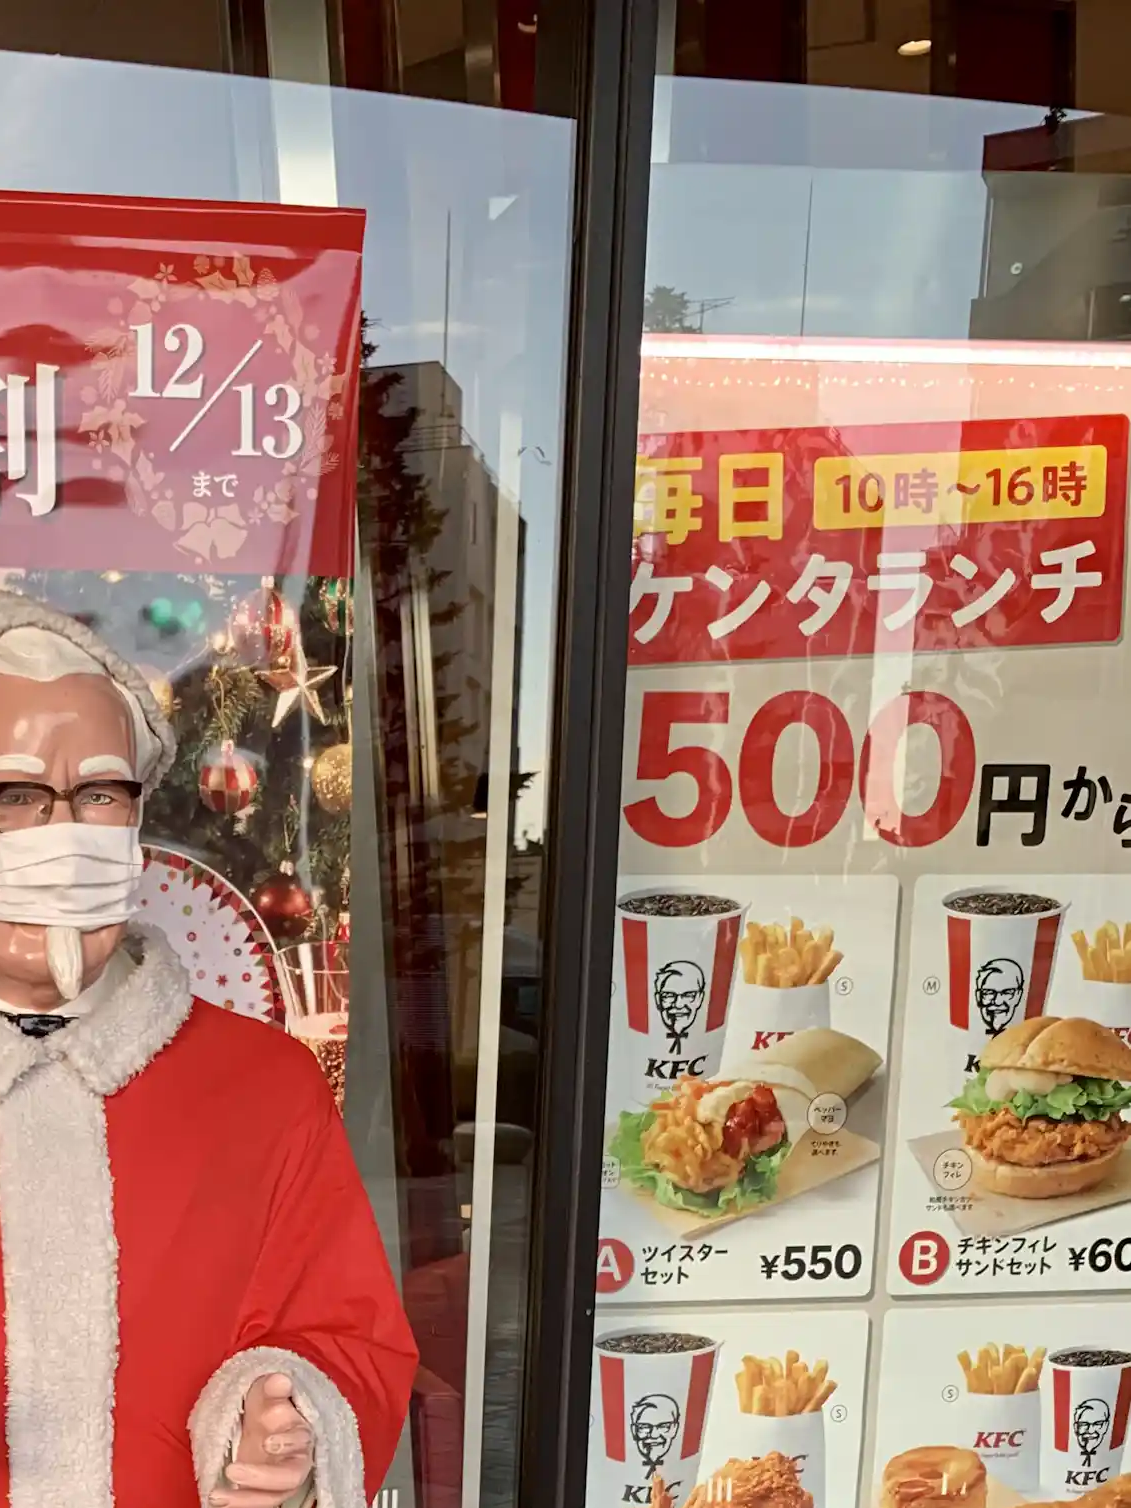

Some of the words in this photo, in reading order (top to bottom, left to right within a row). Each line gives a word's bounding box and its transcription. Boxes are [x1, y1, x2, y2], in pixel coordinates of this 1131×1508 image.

[191, 470, 239, 498] まで
[633, 452, 784, 545] 毎日
[629, 539, 1103, 645] ケンタランチ
[644, 1054, 708, 1080] KFC
[942, 1161, 964, 1170] チキン
[944, 1170, 961, 1179] フィレ
[641, 1244, 728, 1263] ツイスター
[957, 1236, 1057, 1255] チキンフィレ
[596, 1246, 621, 1281] A
[760, 1244, 862, 1281] ¥550
[912, 1240, 938, 1275] B
[956, 1257, 1052, 1276] サンドセット
[640, 1267, 689, 1285] セット
[973, 1430, 1026, 1448] KFC
[1065, 1467, 1110, 1486] KFC
